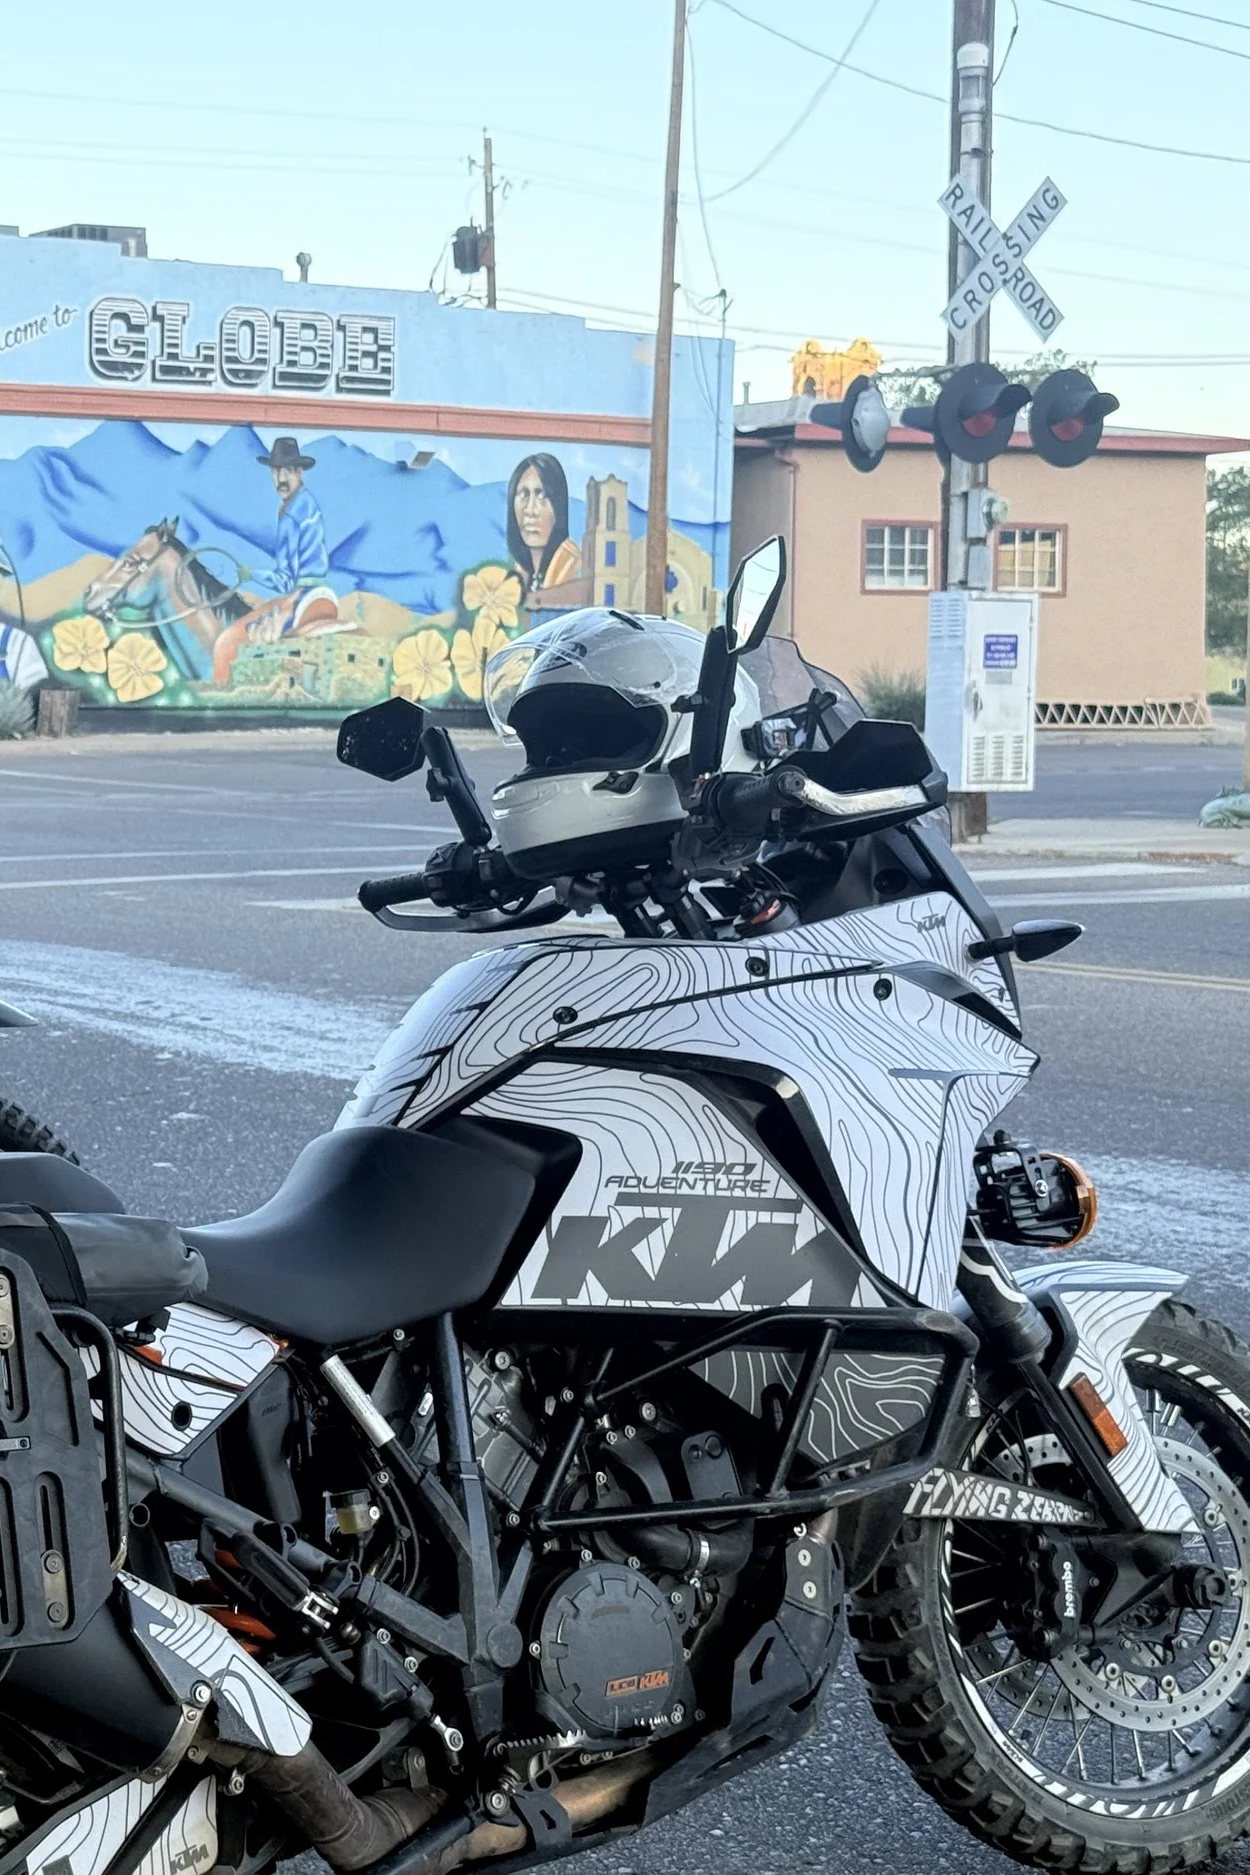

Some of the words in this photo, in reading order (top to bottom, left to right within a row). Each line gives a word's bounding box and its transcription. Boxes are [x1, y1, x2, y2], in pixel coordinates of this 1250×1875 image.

[950, 188, 1059, 330] CROSSING
[52, 304, 78, 327] to
[88, 297, 396, 396] GLOBE
[917, 913, 946, 934] KTM
[604, 1174, 771, 1194] ADVENTURE
[671, 1160, 758, 1176] 1190
[530, 1191, 863, 1306] KTM
[903, 1467, 1011, 1518] FLYING
[1061, 1561, 1076, 1618] brembo
[170, 1844, 209, 1875] KTM
